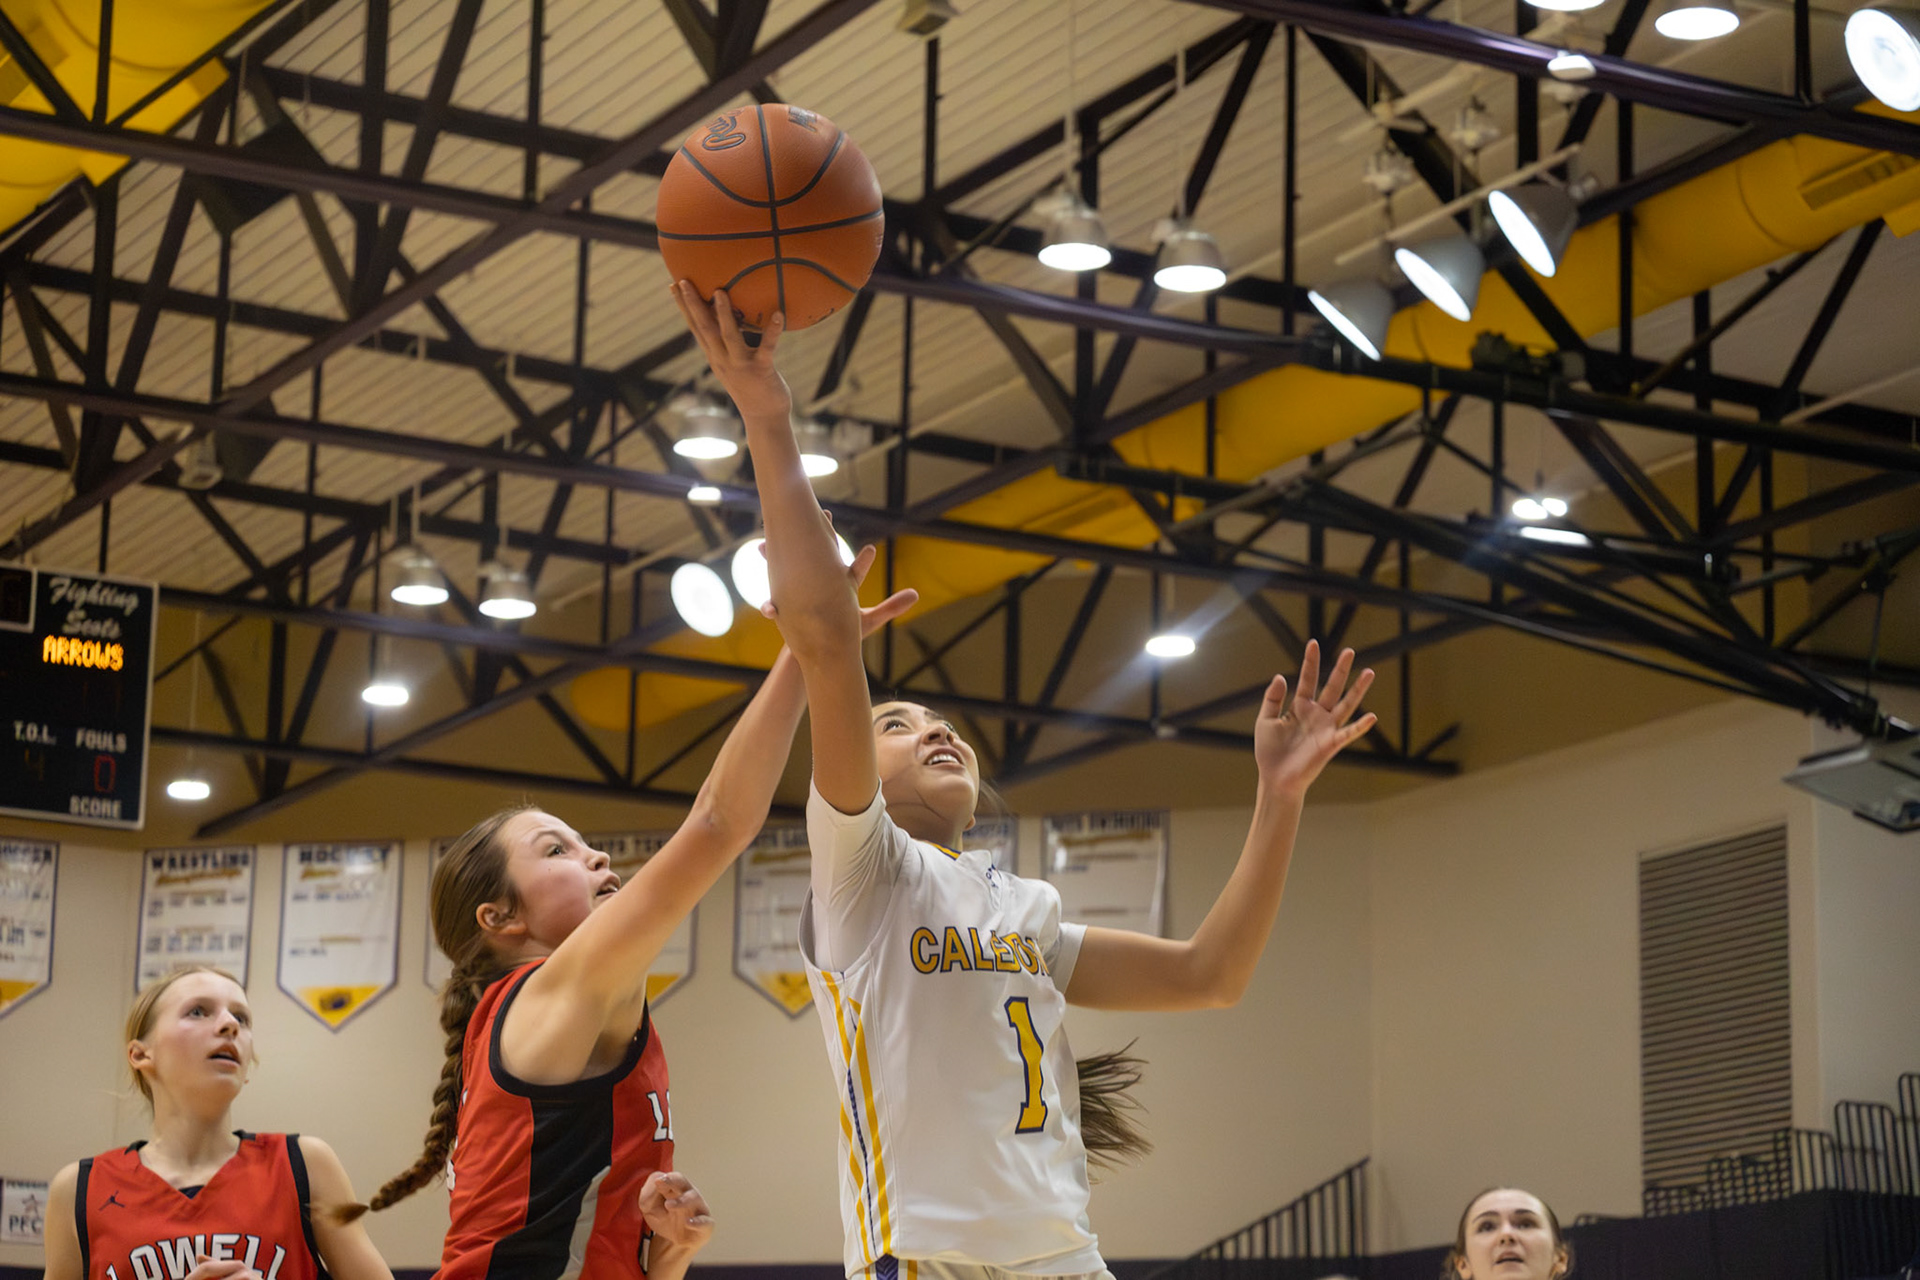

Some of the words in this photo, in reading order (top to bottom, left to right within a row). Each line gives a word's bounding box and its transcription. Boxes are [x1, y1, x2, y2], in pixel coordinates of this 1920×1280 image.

[49, 575, 139, 616] Fighting
[42, 633, 124, 672] ARROWS
[76, 727, 127, 753] FOULS
[69, 794, 122, 819] SCORE
[151, 851, 249, 871] WRESTLING
[1003, 996, 1049, 1134] 1
